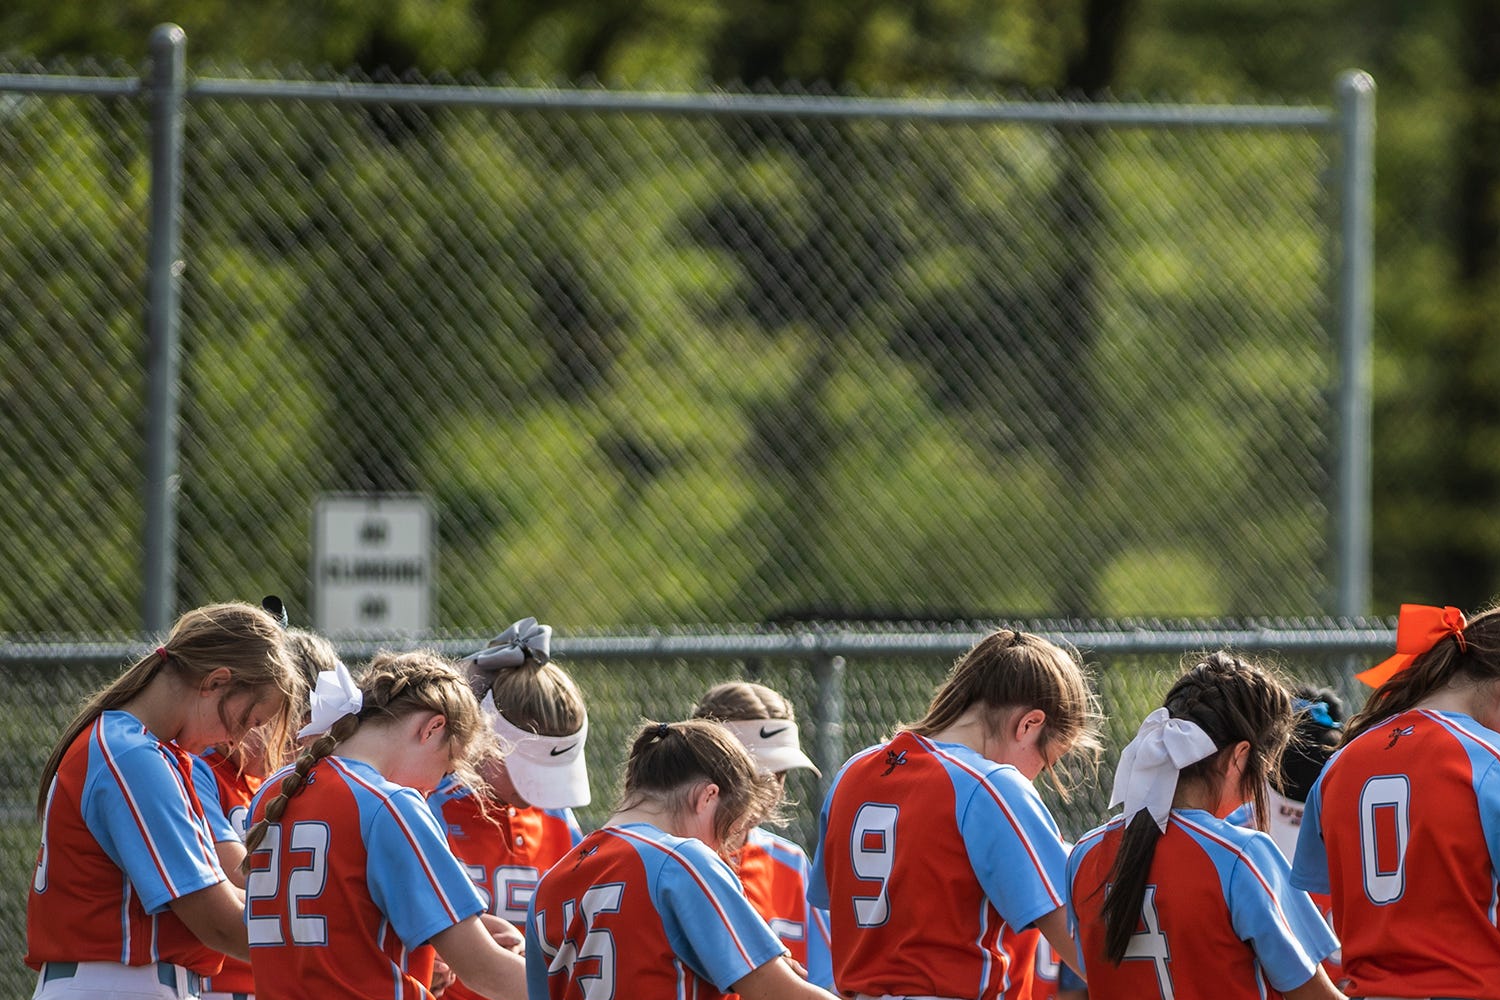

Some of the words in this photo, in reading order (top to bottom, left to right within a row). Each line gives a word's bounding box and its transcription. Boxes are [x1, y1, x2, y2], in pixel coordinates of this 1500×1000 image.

[246, 821, 331, 948] 22
[849, 802, 899, 929] 9
[1358, 773, 1411, 906] 0
